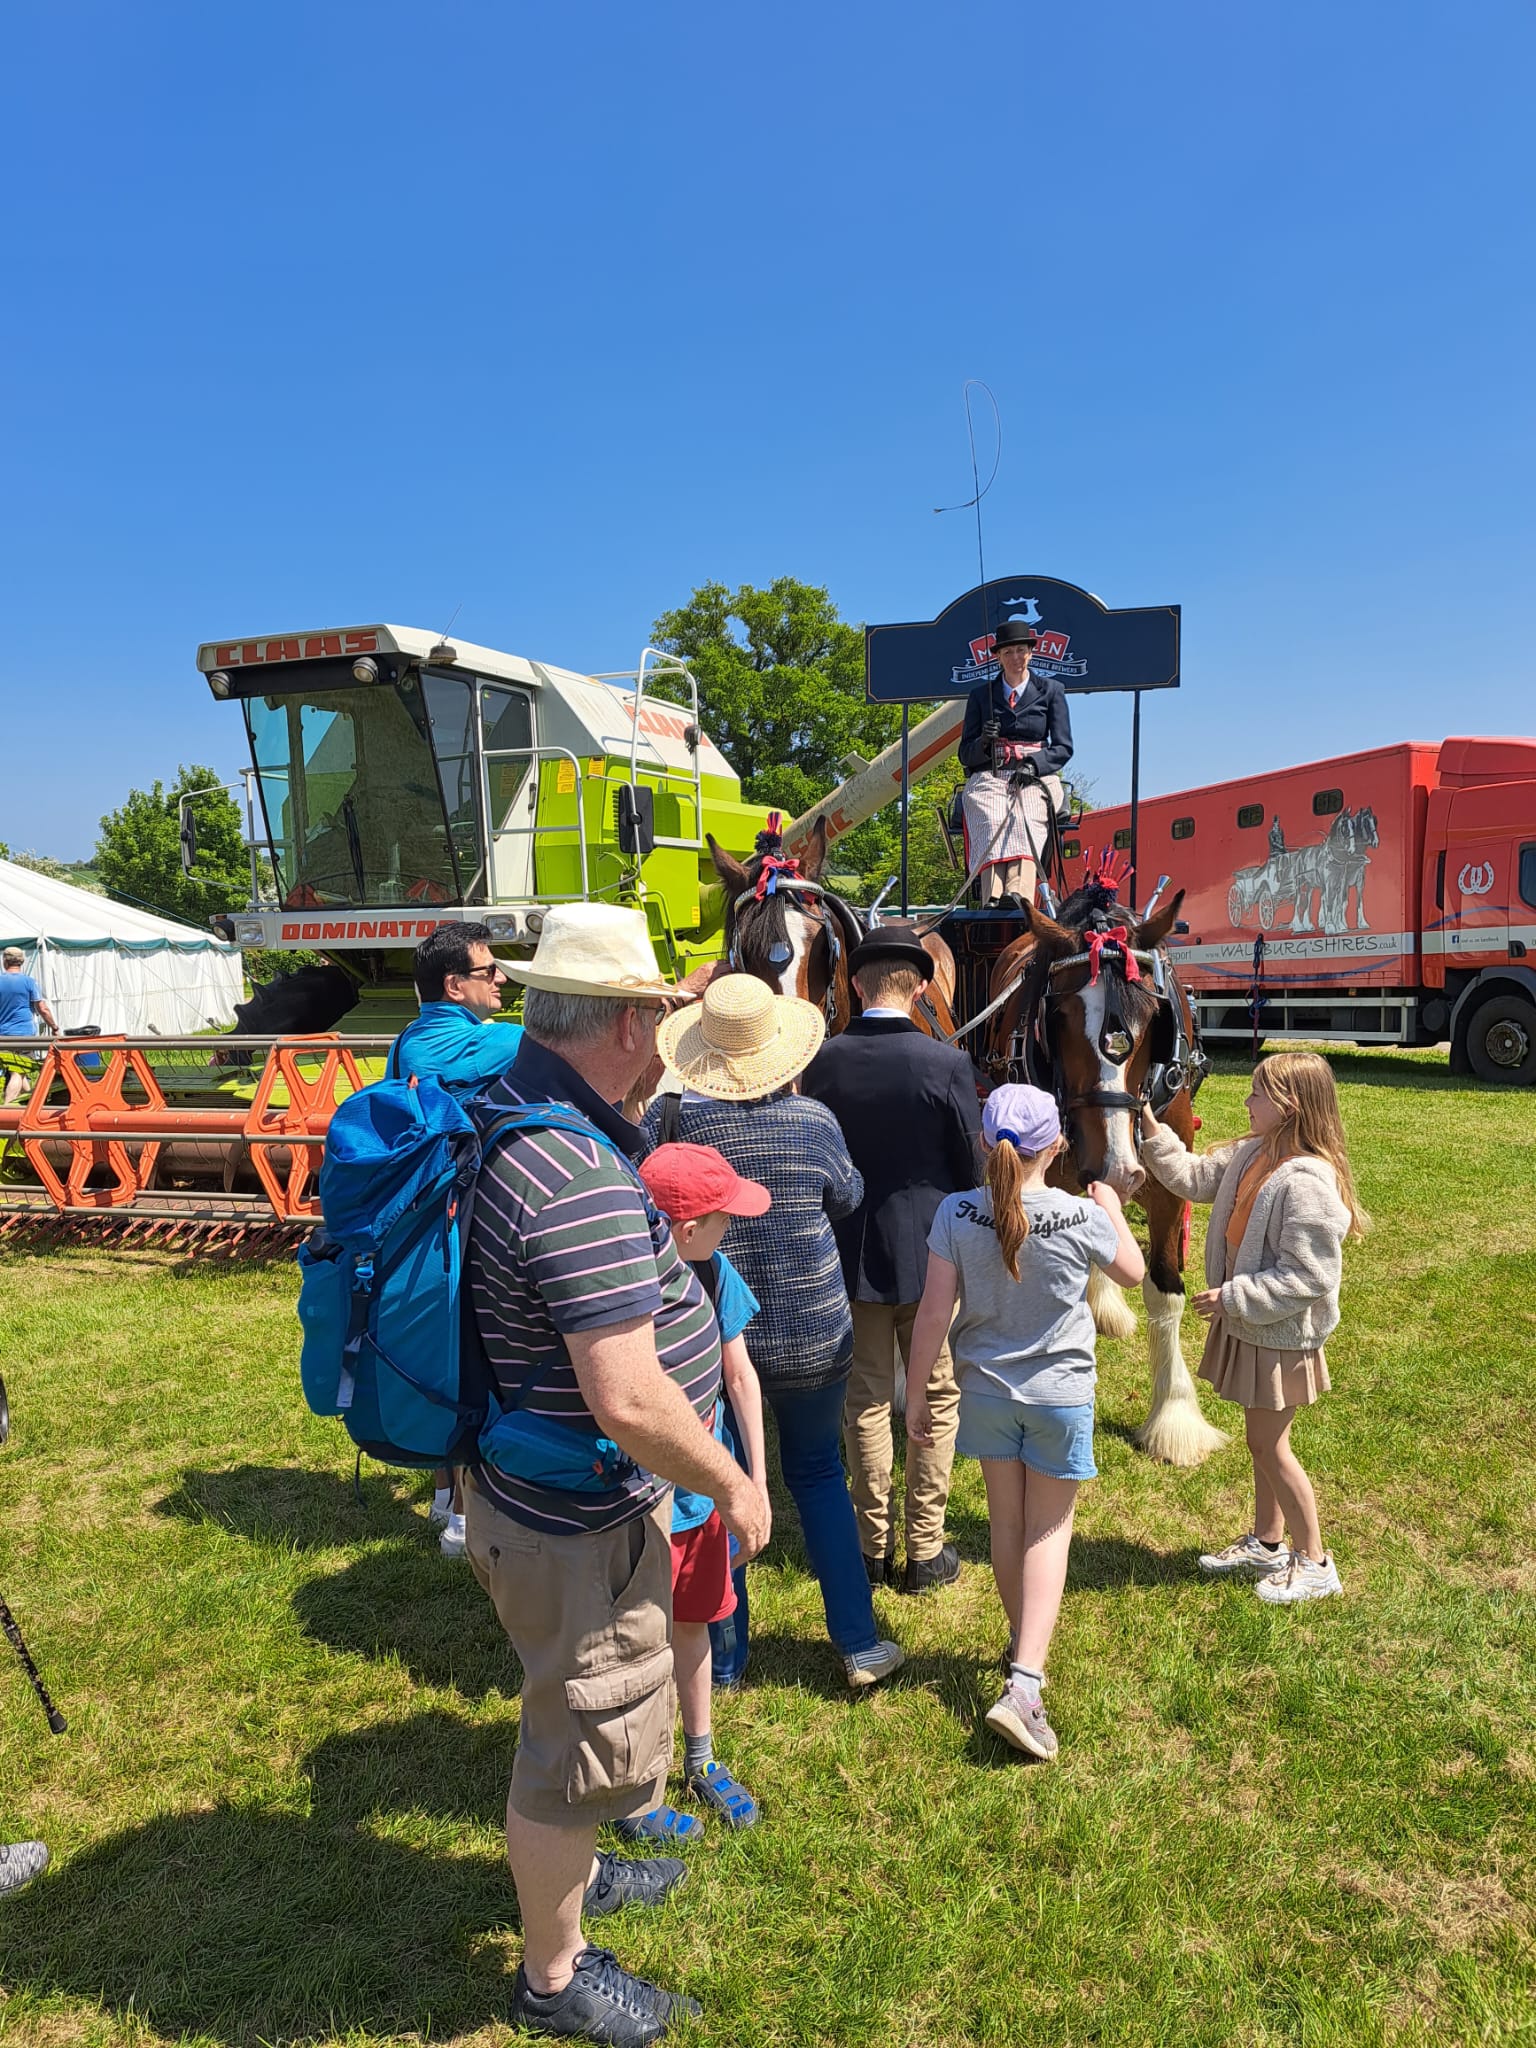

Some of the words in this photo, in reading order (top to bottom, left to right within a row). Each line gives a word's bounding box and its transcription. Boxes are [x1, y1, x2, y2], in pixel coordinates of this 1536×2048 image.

[216, 631, 377, 666] CLAAS
[281, 920, 460, 940] DOMINATO
[1029, 1206, 1089, 1239] iginal
